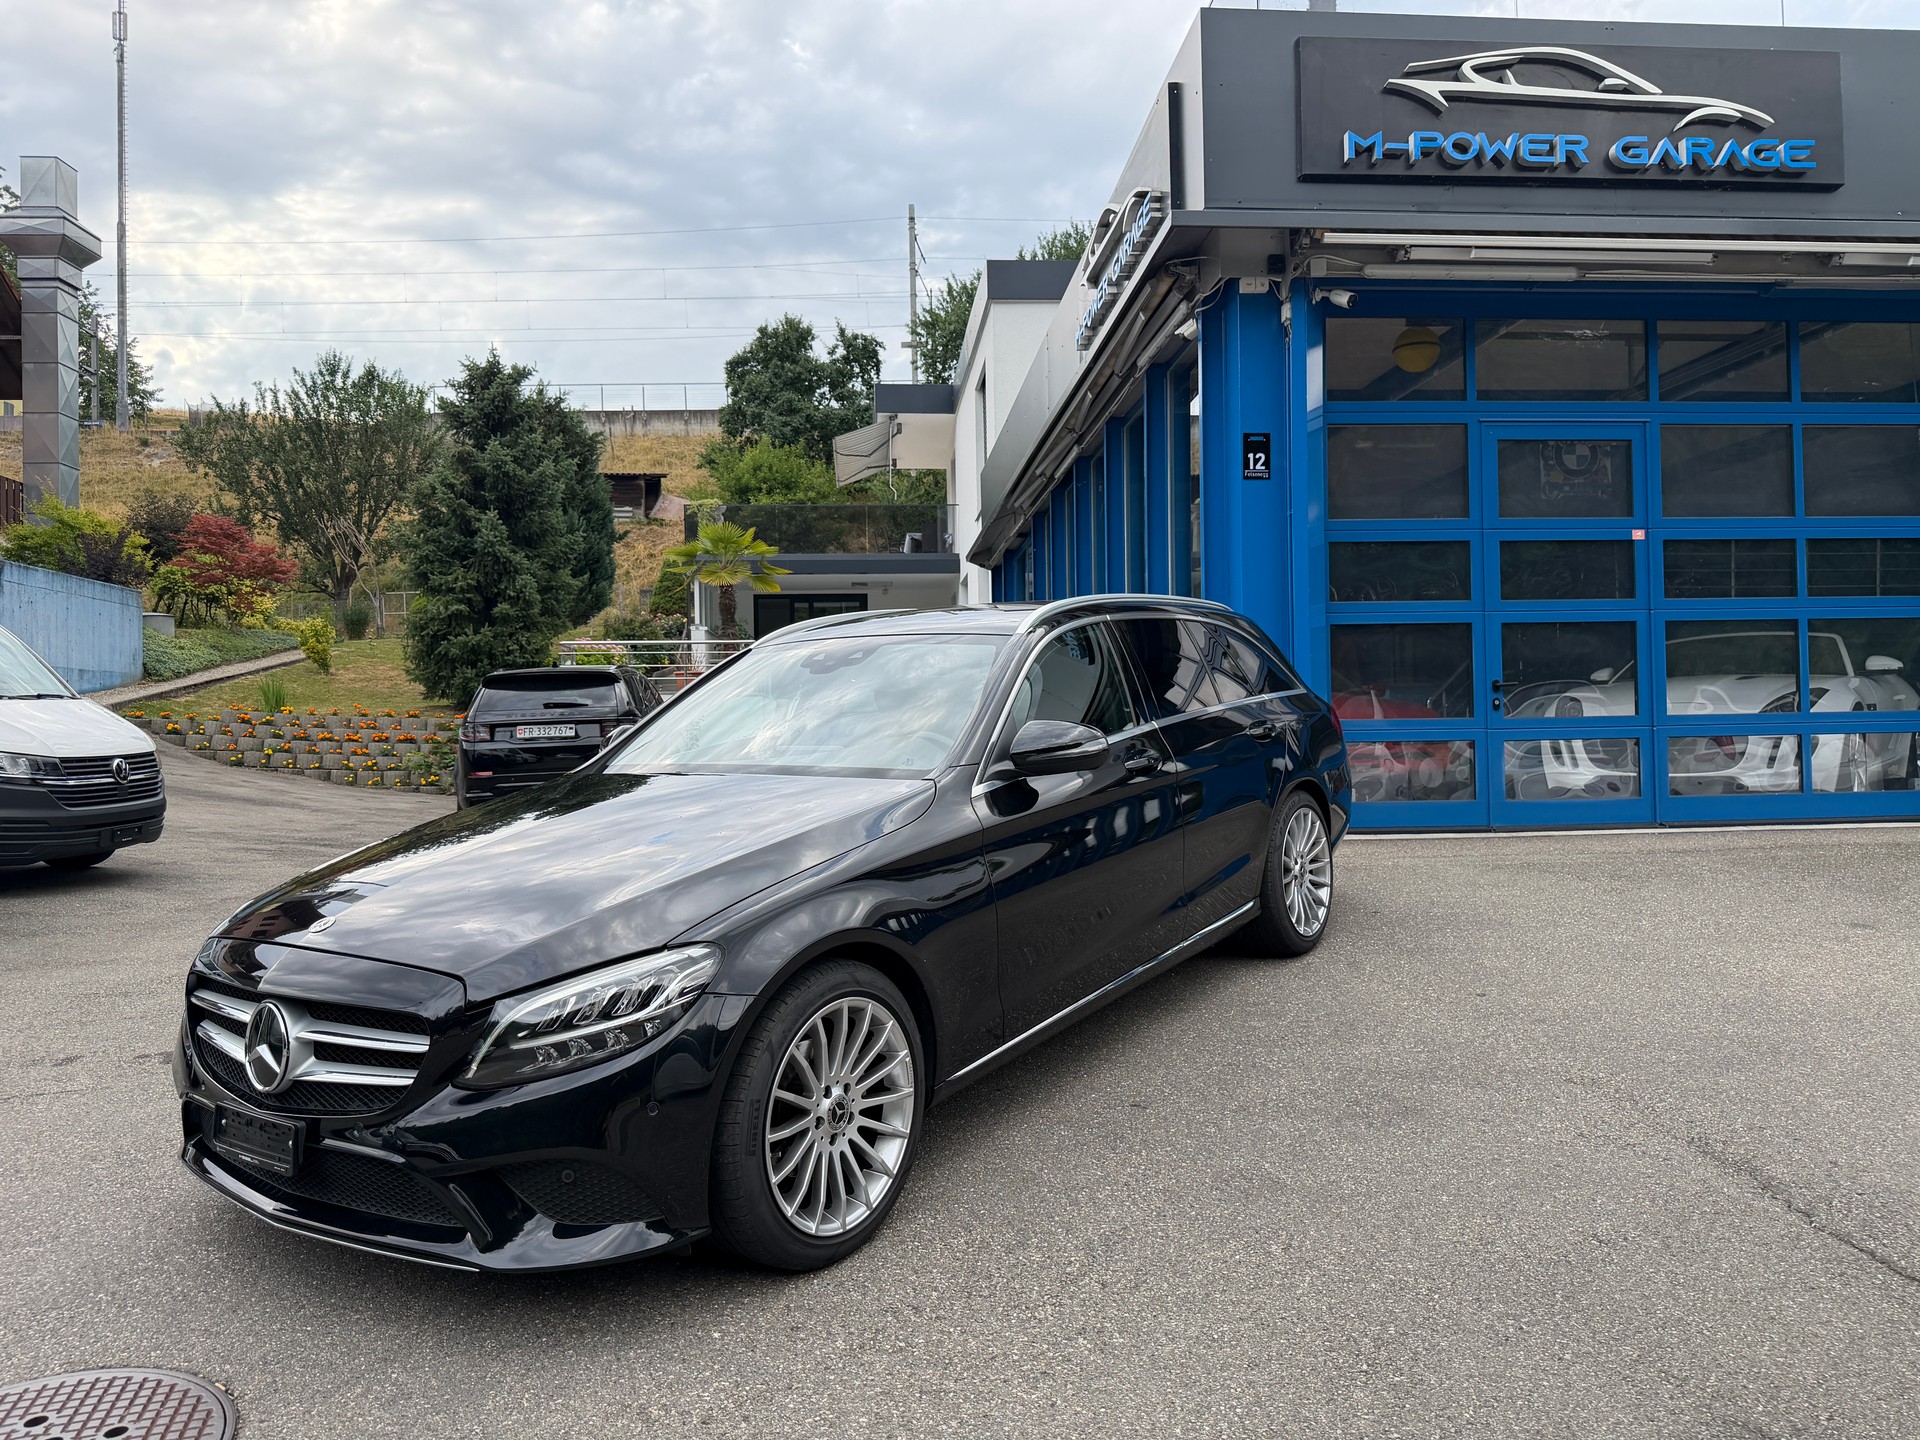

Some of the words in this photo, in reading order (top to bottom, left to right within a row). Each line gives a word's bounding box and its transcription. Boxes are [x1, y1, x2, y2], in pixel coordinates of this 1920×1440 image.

[1343, 129, 1590, 166] M-POWER
[1608, 135, 1817, 170] GARAGE
[1111, 191, 1153, 282] GARAGE
[1247, 452, 1266, 470] 12
